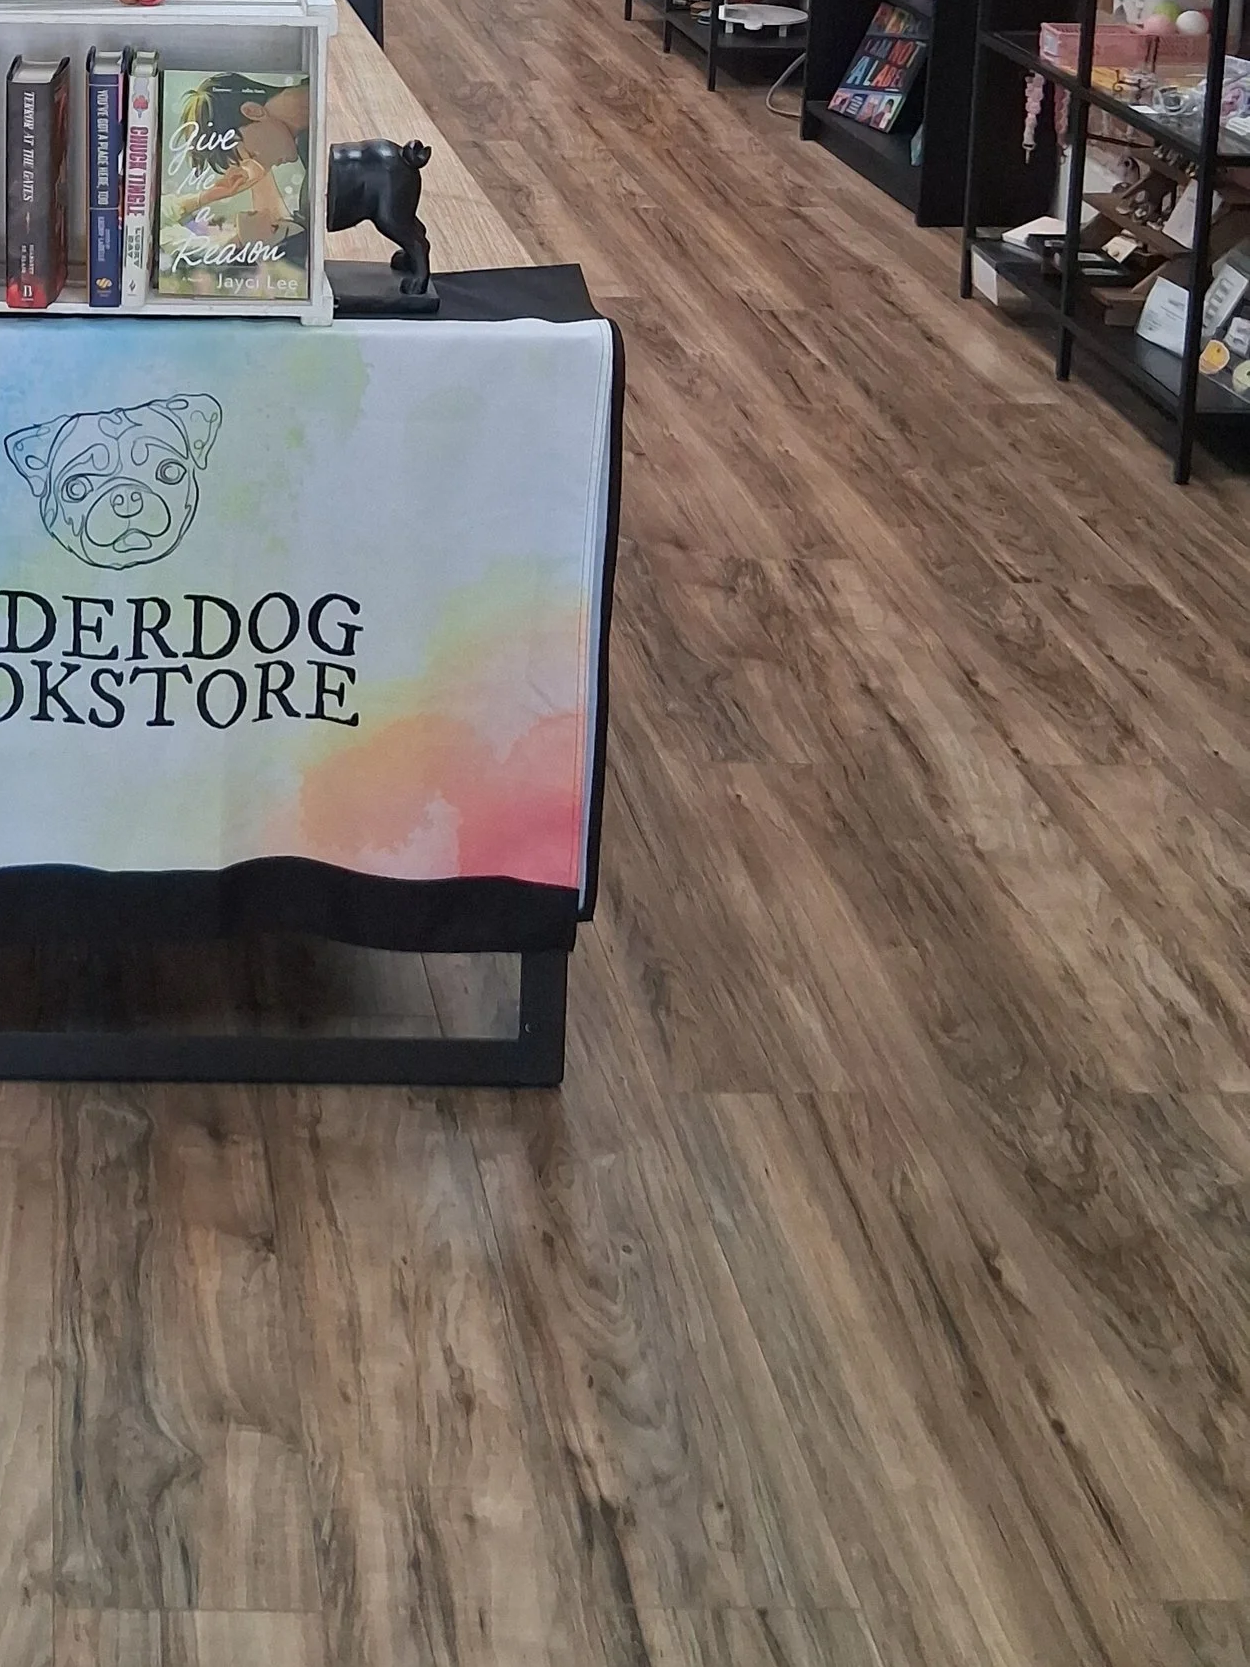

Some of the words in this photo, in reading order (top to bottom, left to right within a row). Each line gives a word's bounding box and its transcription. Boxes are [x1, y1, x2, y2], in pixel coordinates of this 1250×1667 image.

[23, 91, 35, 130] TERROR
[97, 118, 109, 133] GOT
[23, 135, 34, 146] AT
[128, 125, 149, 170] CHUCK
[168, 121, 239, 176] Give
[23, 149, 34, 168] THE
[97, 142, 109, 165] PLACE
[22, 170, 34, 203] GATES
[177, 166, 216, 194] Me
[97, 191, 109, 205] TOO
[127, 173, 147, 217] TINGLE
[195, 206, 216, 223] a
[171, 236, 286, 273] Reason
[216, 273, 260, 295] Jayci
[267, 274, 299, 291] Lee
